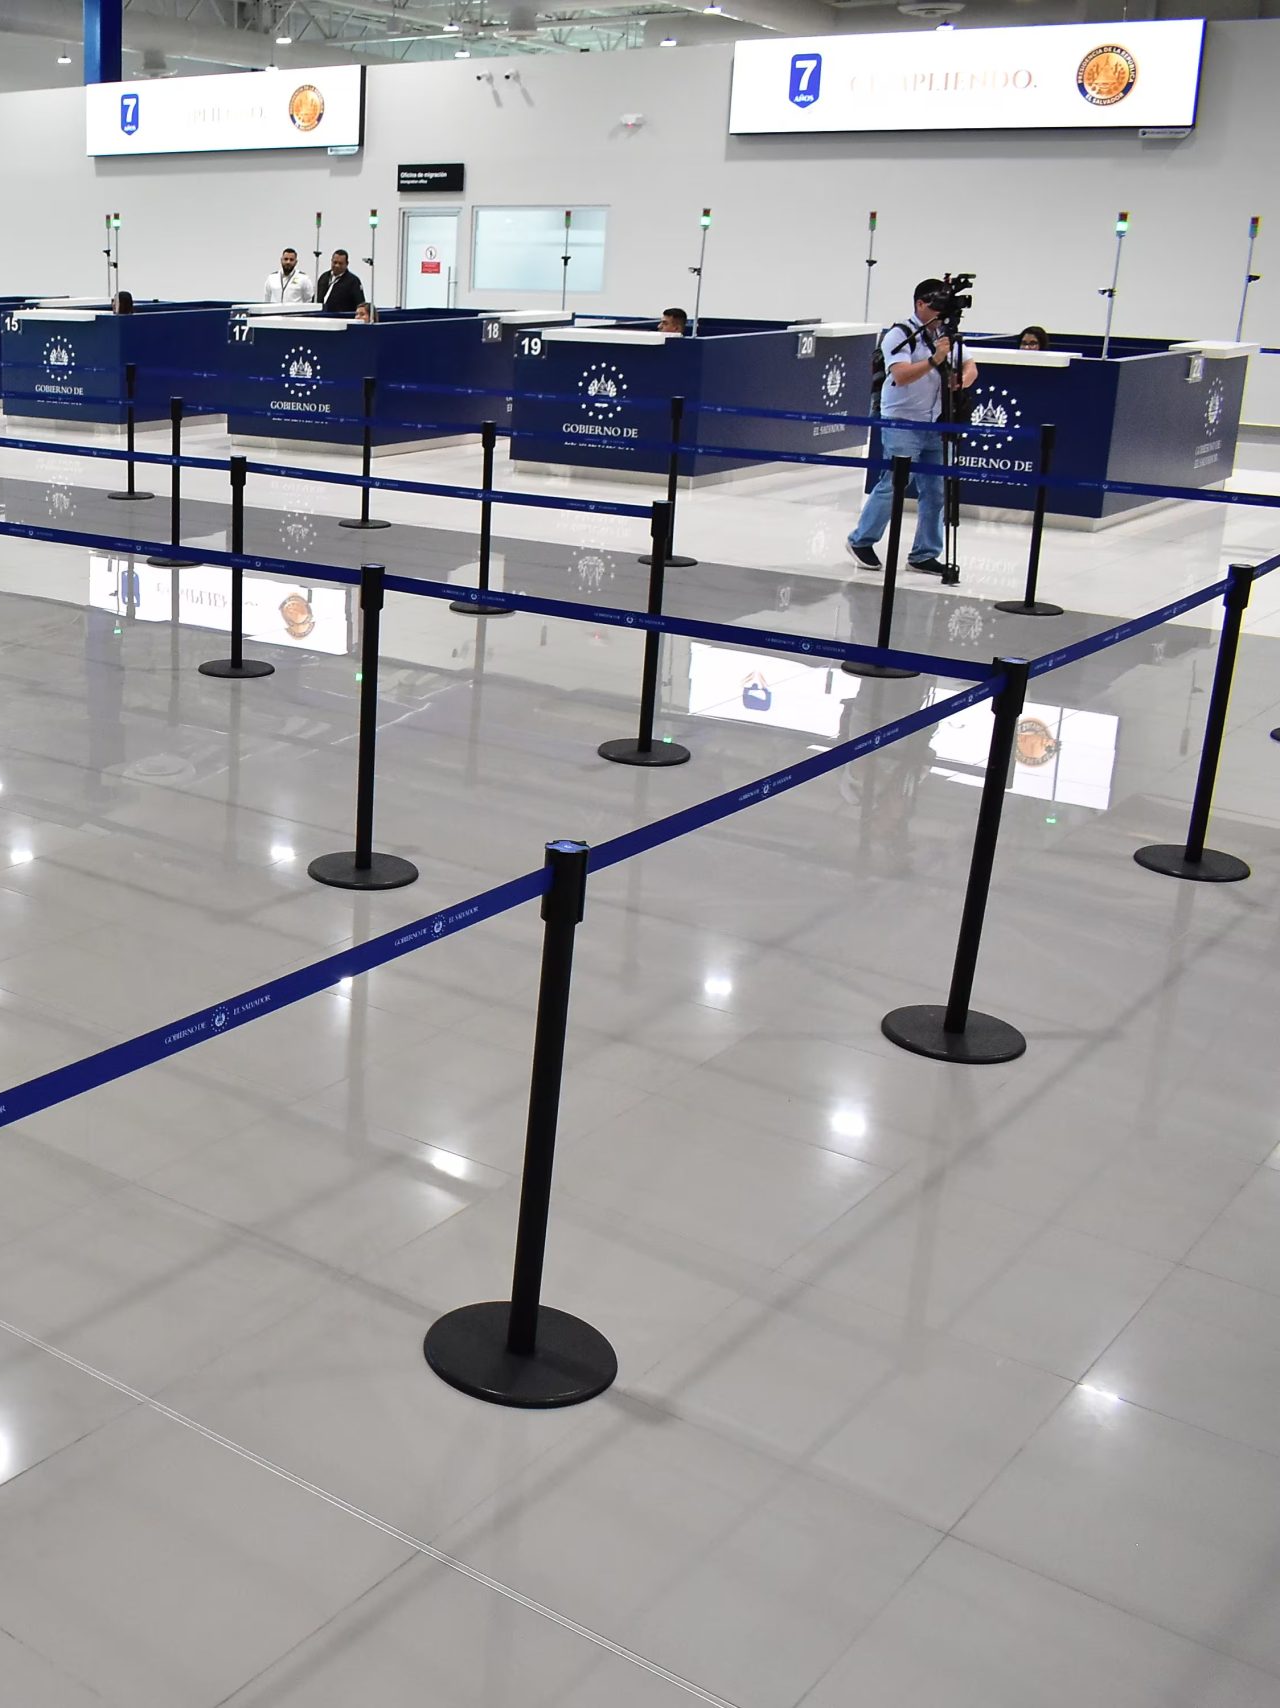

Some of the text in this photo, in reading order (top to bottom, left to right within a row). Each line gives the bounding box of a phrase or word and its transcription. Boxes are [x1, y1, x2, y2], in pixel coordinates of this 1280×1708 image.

[795, 60, 818, 91] 7
[123, 98, 137, 123] 7
[5, 316, 19, 331] 15
[486, 322, 499, 339] 18
[233, 325, 250, 341] 17
[521, 337, 542, 356] 19
[801, 337, 814, 354] 20
[35, 384, 84, 395] GOBIERNO DE
[270, 400, 331, 413] GOBIERNO DE
[562, 423, 639, 439] GOBIERNO DE
[1014, 461, 1033, 472] DE
